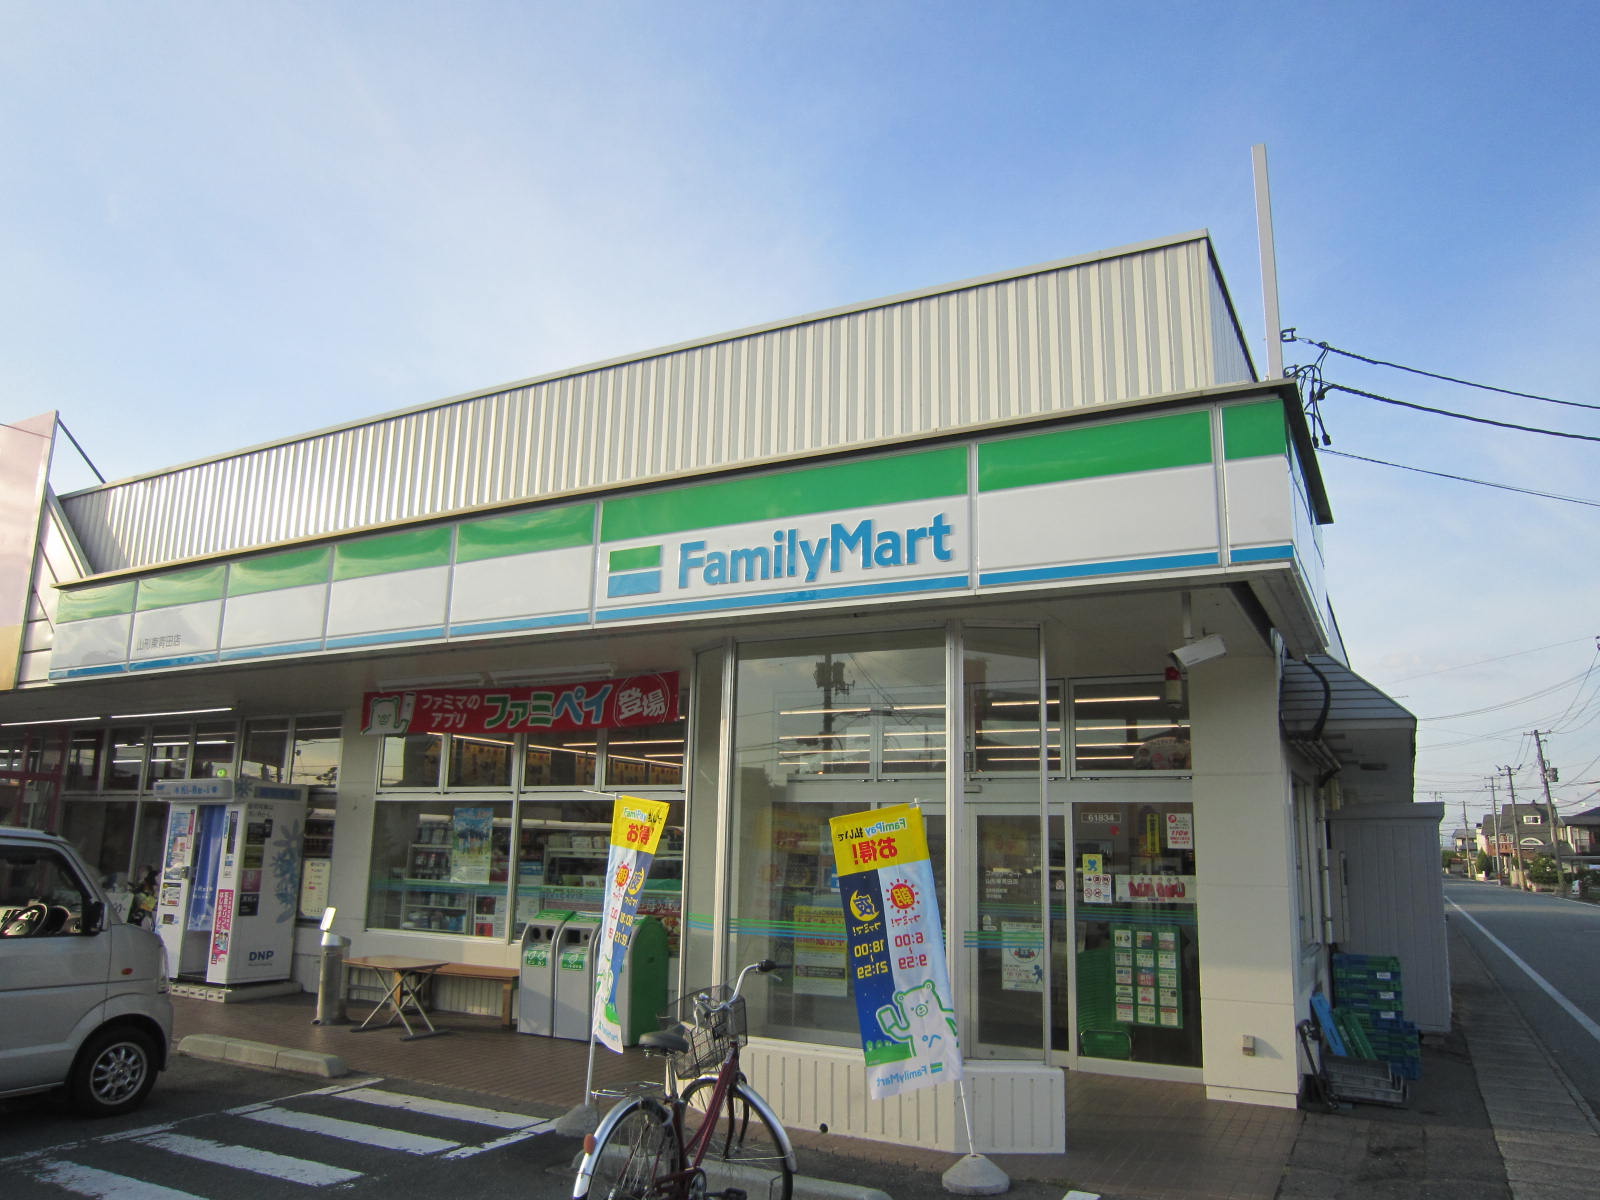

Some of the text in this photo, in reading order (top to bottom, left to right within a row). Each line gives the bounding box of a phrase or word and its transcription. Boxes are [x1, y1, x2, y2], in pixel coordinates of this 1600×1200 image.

[678, 512, 953, 589] FamilyMart
[421, 693, 480, 711] ファミマの
[484, 684, 614, 730] ファミペイ
[618, 688, 667, 719] 登場
[431, 712, 467, 730] アプリ
[623, 807, 648, 822] FamiPay
[248, 950, 275, 962] DNP
